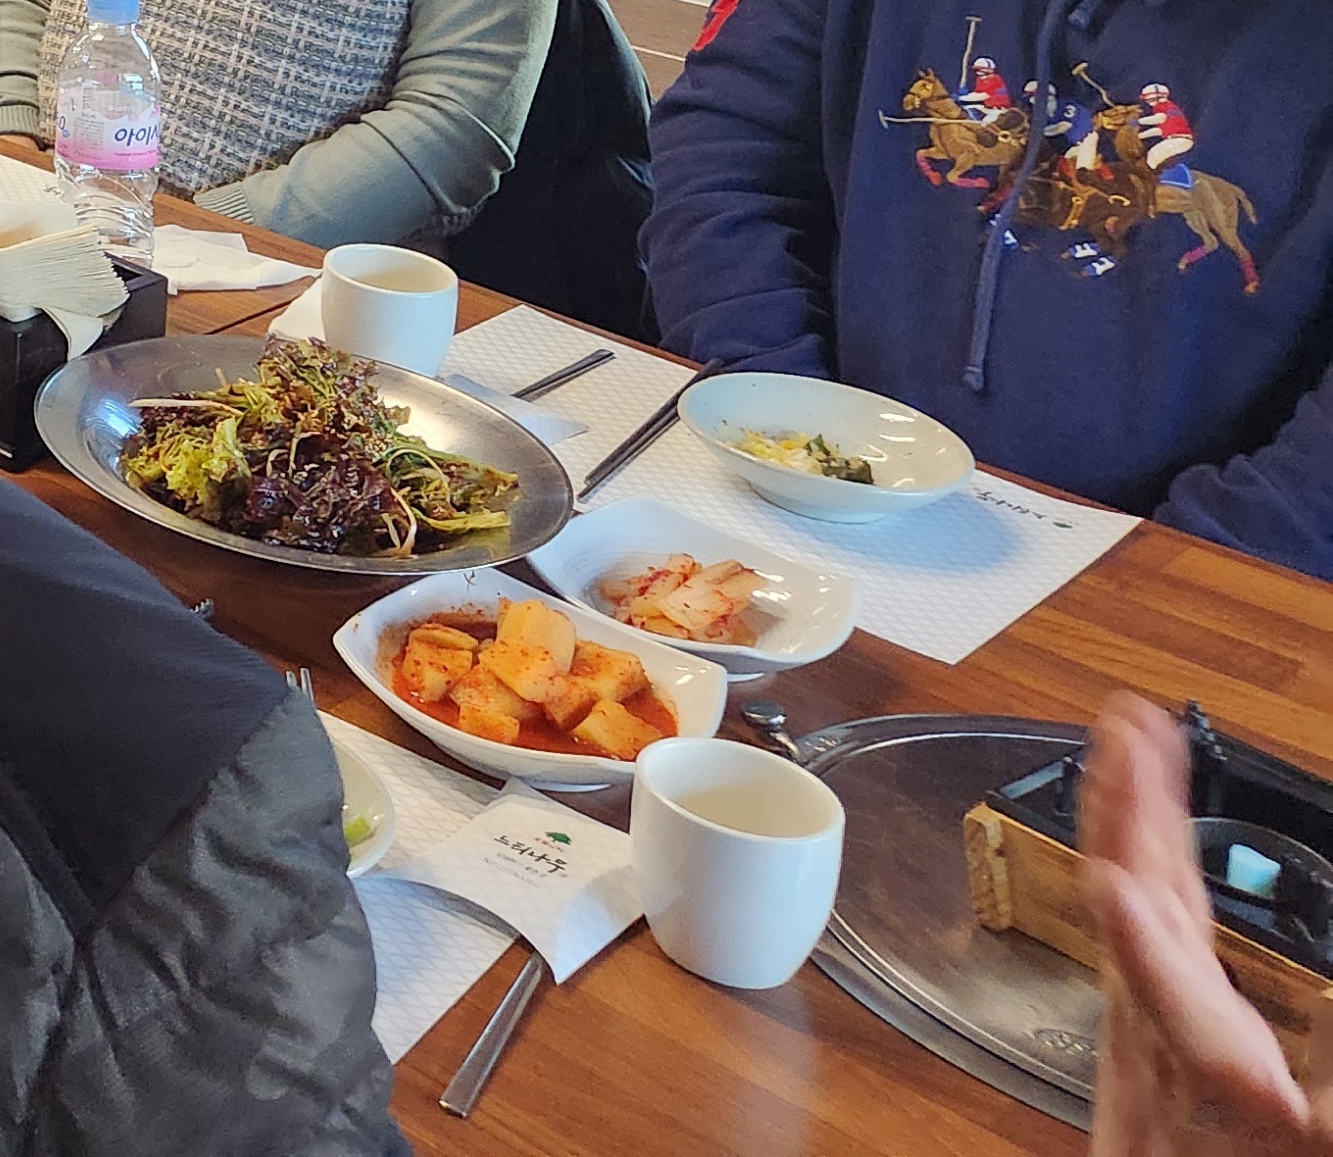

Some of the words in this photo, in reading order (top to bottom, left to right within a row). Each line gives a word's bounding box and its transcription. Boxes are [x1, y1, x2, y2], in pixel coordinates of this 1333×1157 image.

[1063, 104, 1077, 119] 3
[114, 125, 160, 147] 아이
[493, 834, 569, 874] 느티나무
